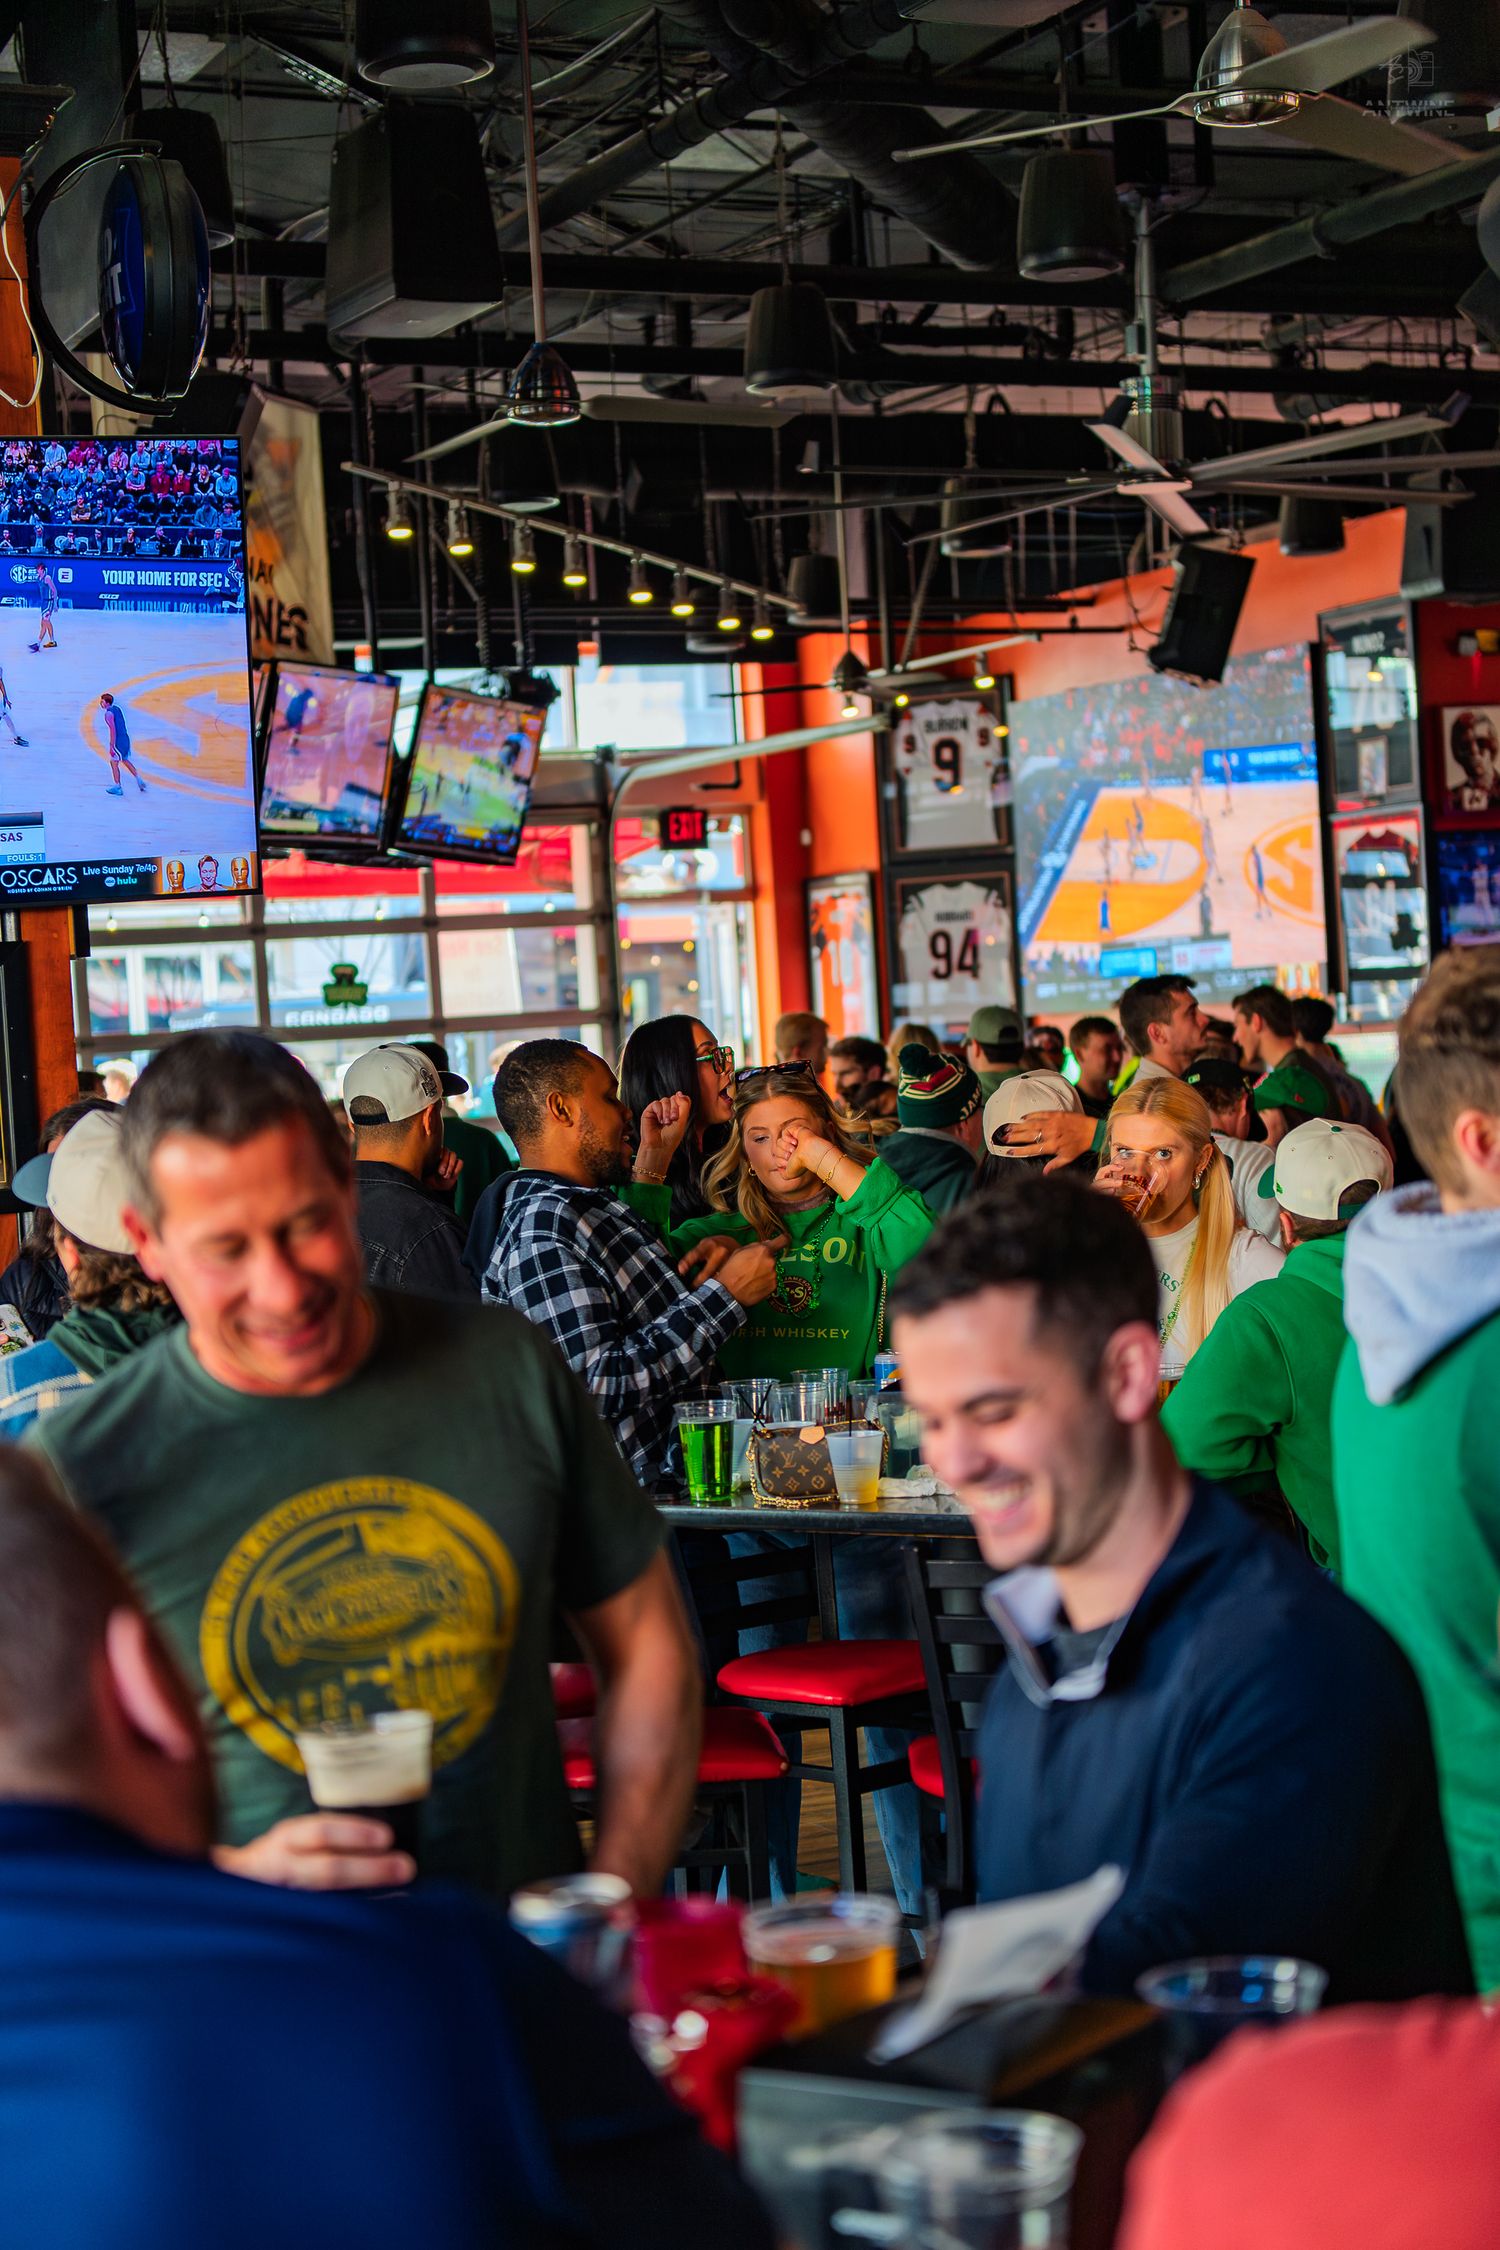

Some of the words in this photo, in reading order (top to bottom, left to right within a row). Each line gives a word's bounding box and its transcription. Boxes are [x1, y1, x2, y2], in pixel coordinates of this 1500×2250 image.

[12, 566, 27, 582] SEC
[102, 569, 135, 585] YOUR
[137, 569, 171, 586] HOME
[174, 570, 197, 587] FOR
[199, 571, 222, 587] SEC
[934, 737, 961, 793] 9
[669, 811, 703, 842] EXIT
[83, 867, 100, 876] Live
[102, 865, 134, 876] Sunday
[136, 864, 158, 873] 7e/4p
[117, 876, 138, 885] hulu
[929, 928, 980, 980] 94
[773, 1328, 850, 1339] WHISKEY
